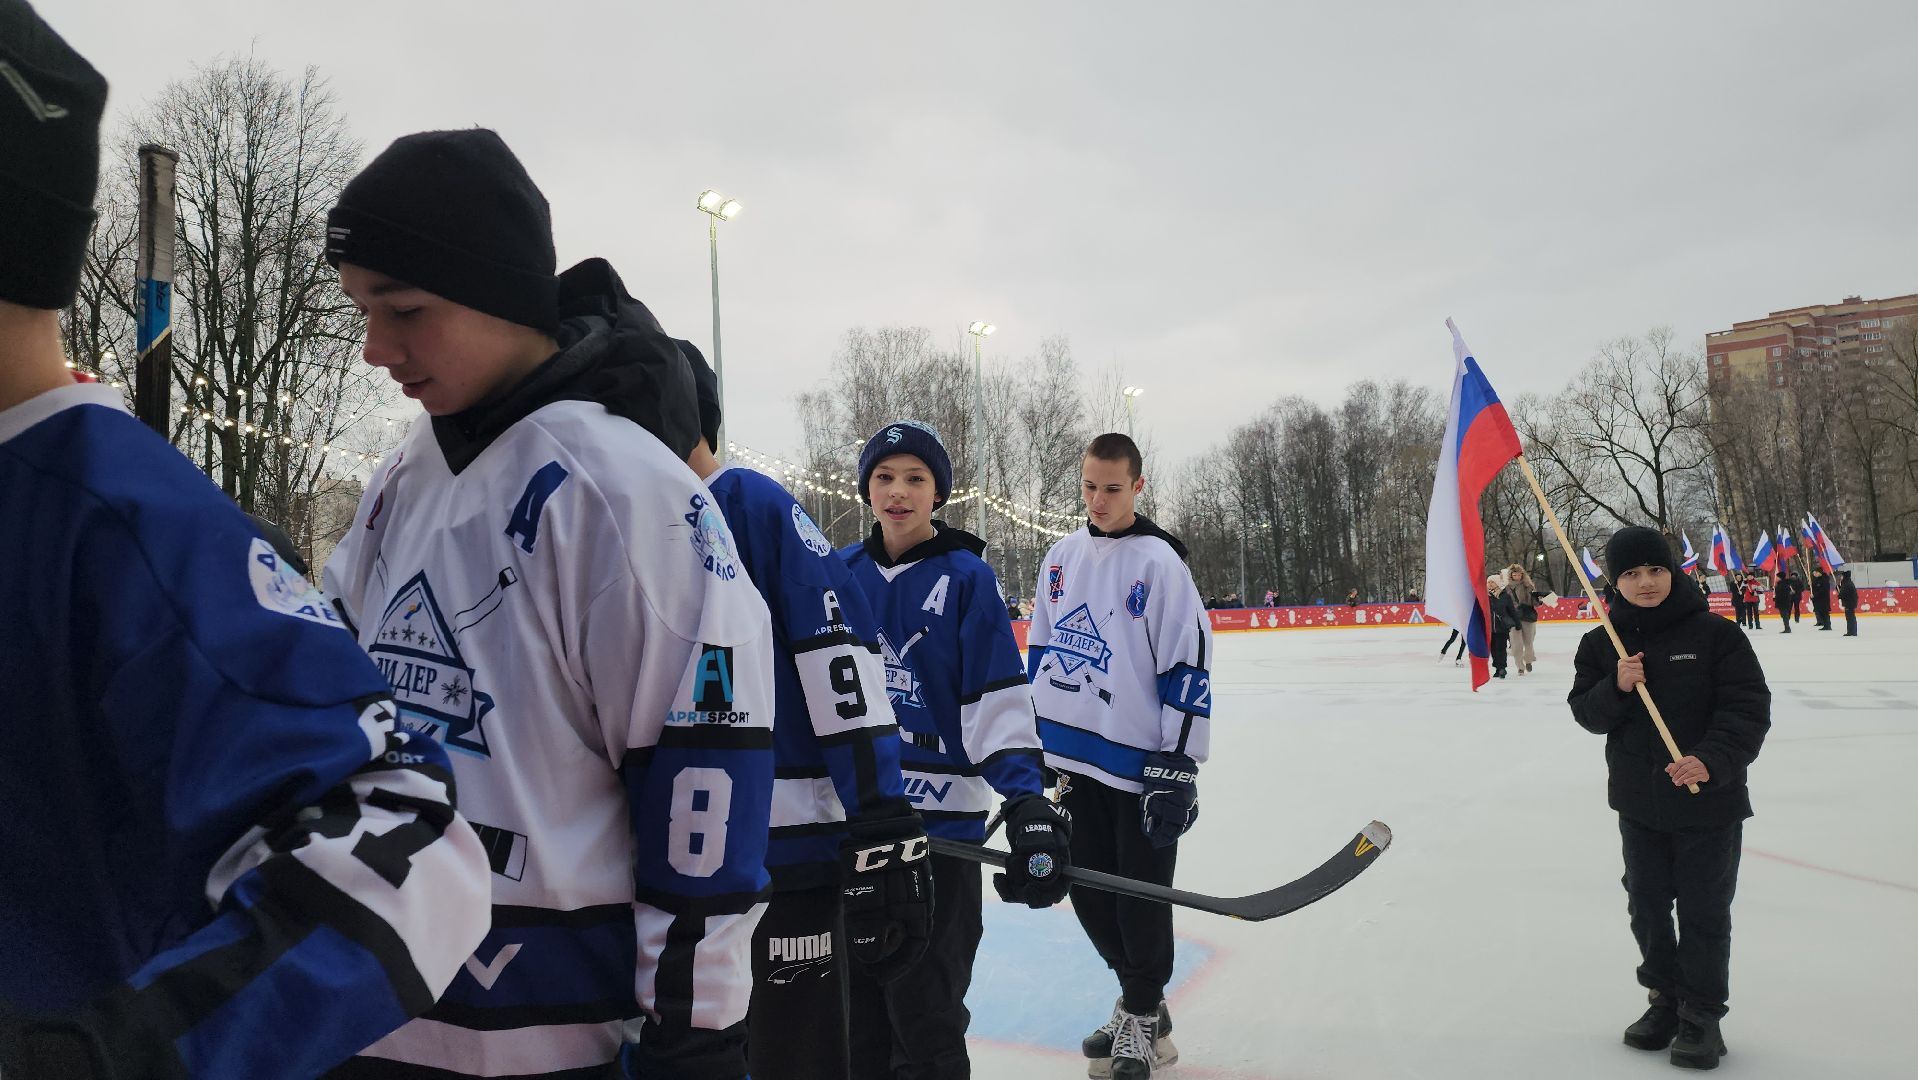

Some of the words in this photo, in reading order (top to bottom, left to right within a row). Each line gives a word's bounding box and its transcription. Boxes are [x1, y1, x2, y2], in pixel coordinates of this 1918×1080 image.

[504, 460, 569, 554] A
[921, 574, 951, 617] A
[1054, 631, 1096, 652] ЛИДЕР
[828, 654, 868, 721] 9
[1179, 673, 1210, 709] 12
[666, 711, 750, 724] APRESPORT
[666, 766, 734, 878] 8
[1024, 824, 1053, 833] LEADER
[768, 931, 832, 962] PUMA
